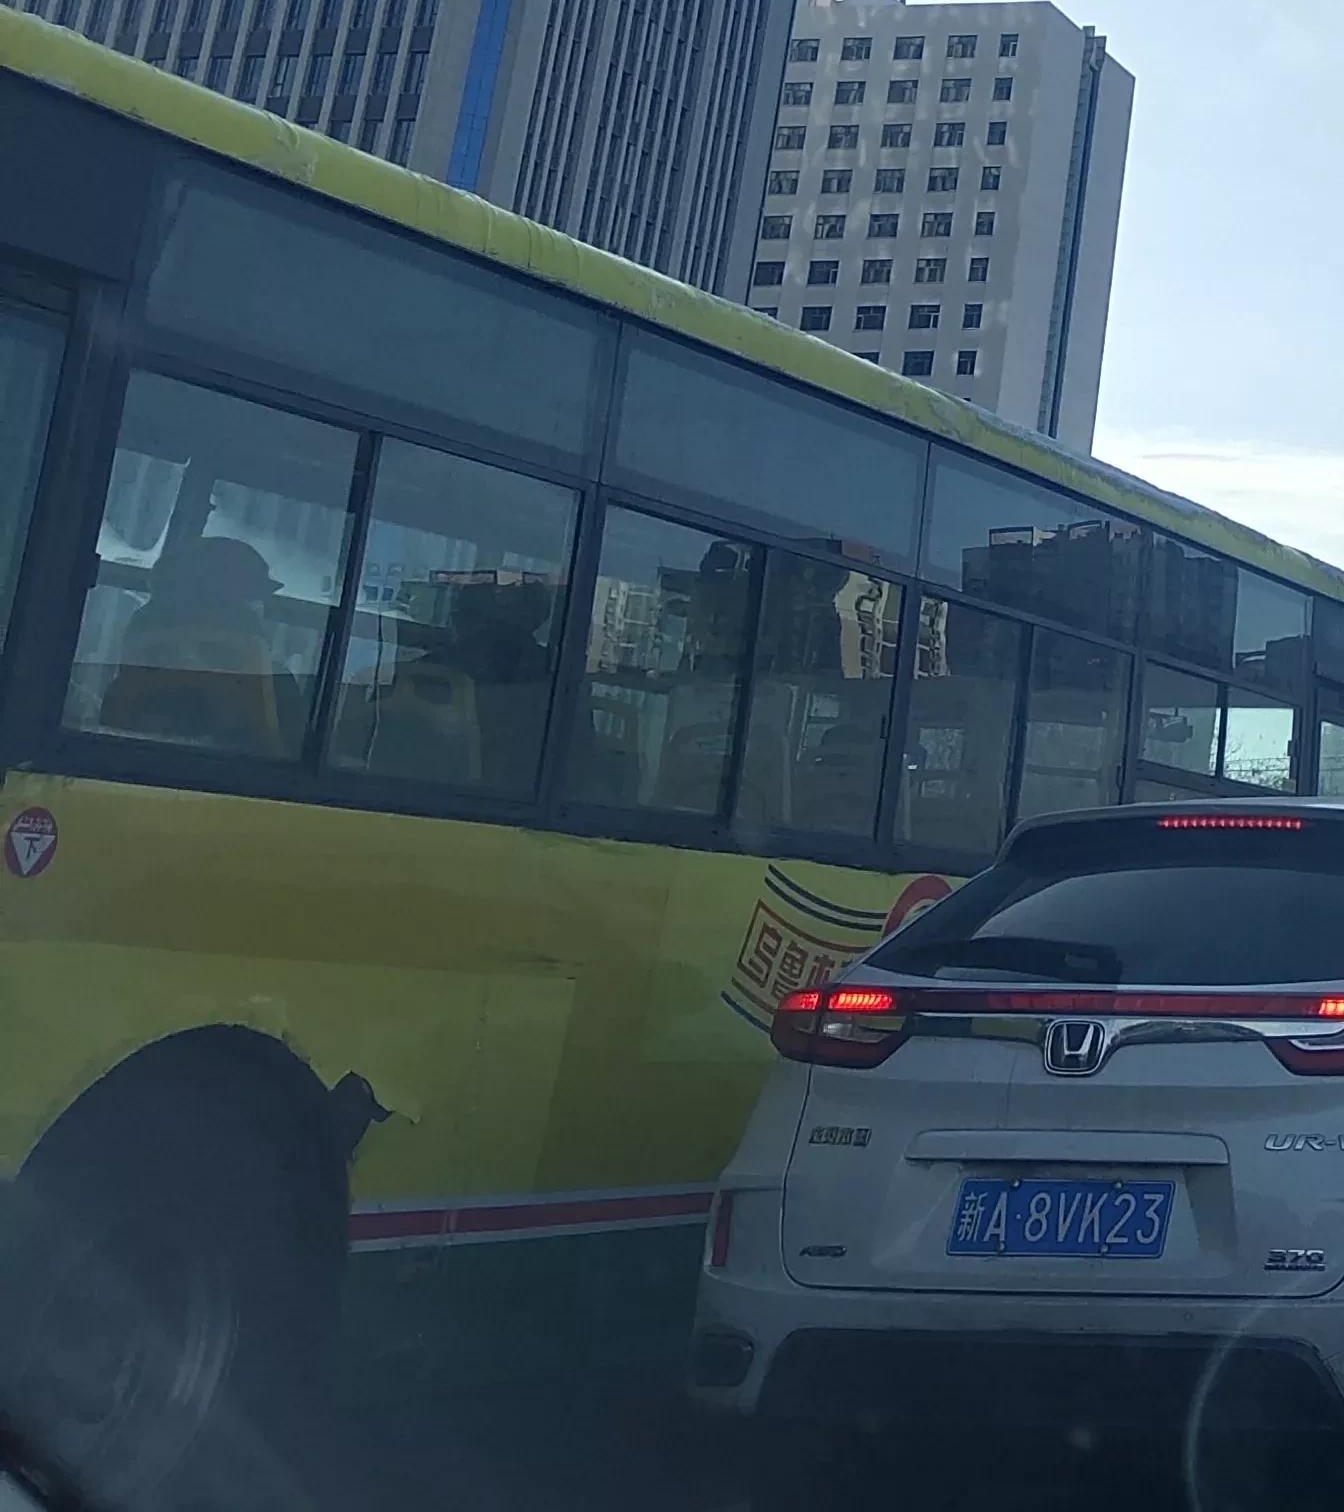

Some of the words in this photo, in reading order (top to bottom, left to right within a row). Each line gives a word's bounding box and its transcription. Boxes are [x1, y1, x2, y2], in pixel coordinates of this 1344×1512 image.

[748, 922, 856, 997] 乌鲁木
[957, 1191, 1165, 1244] 新A·8VK23
